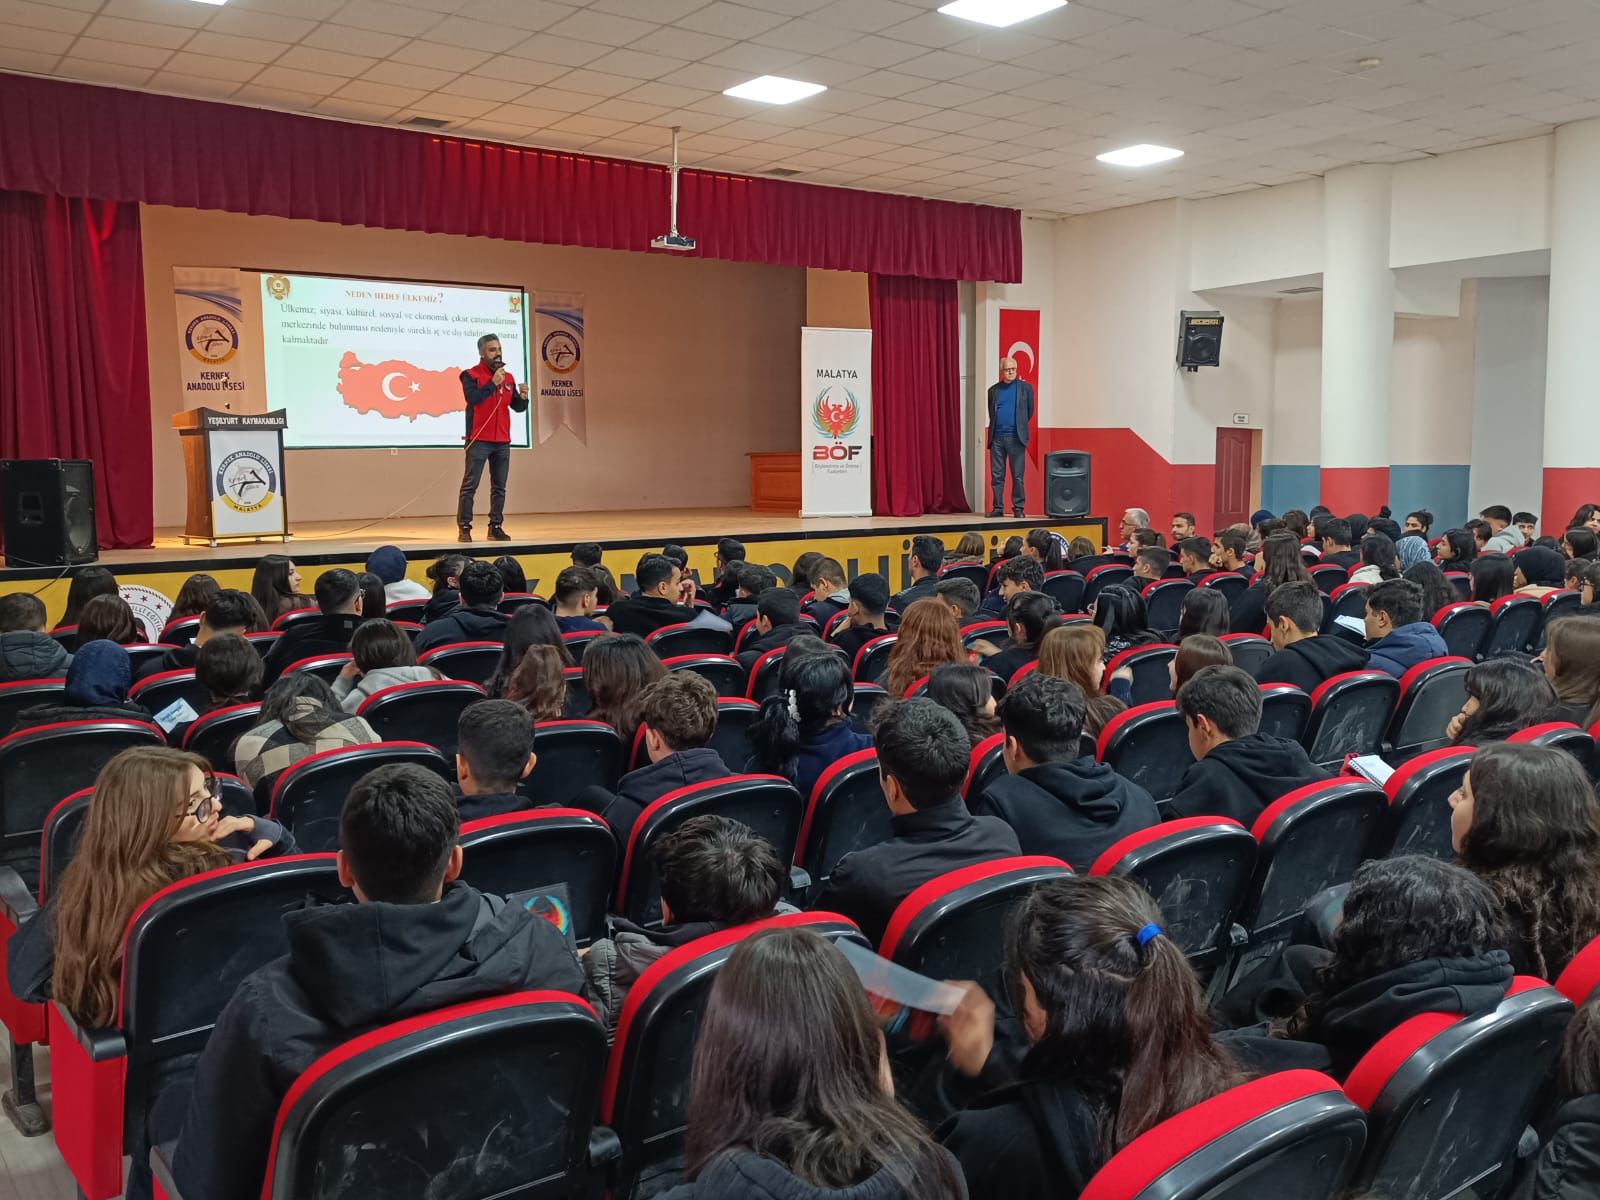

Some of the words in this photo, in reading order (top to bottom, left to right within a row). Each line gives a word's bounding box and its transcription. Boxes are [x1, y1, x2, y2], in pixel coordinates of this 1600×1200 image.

[200, 371, 230, 380] KERNEK
[816, 368, 858, 379] MALATYA
[187, 382, 220, 391] ANADOLU
[222, 381, 245, 391] LSESİ
[551, 380, 573, 388] KERNEK
[541, 389, 566, 397] ANADOLU
[813, 441, 862, 460] BÖF
